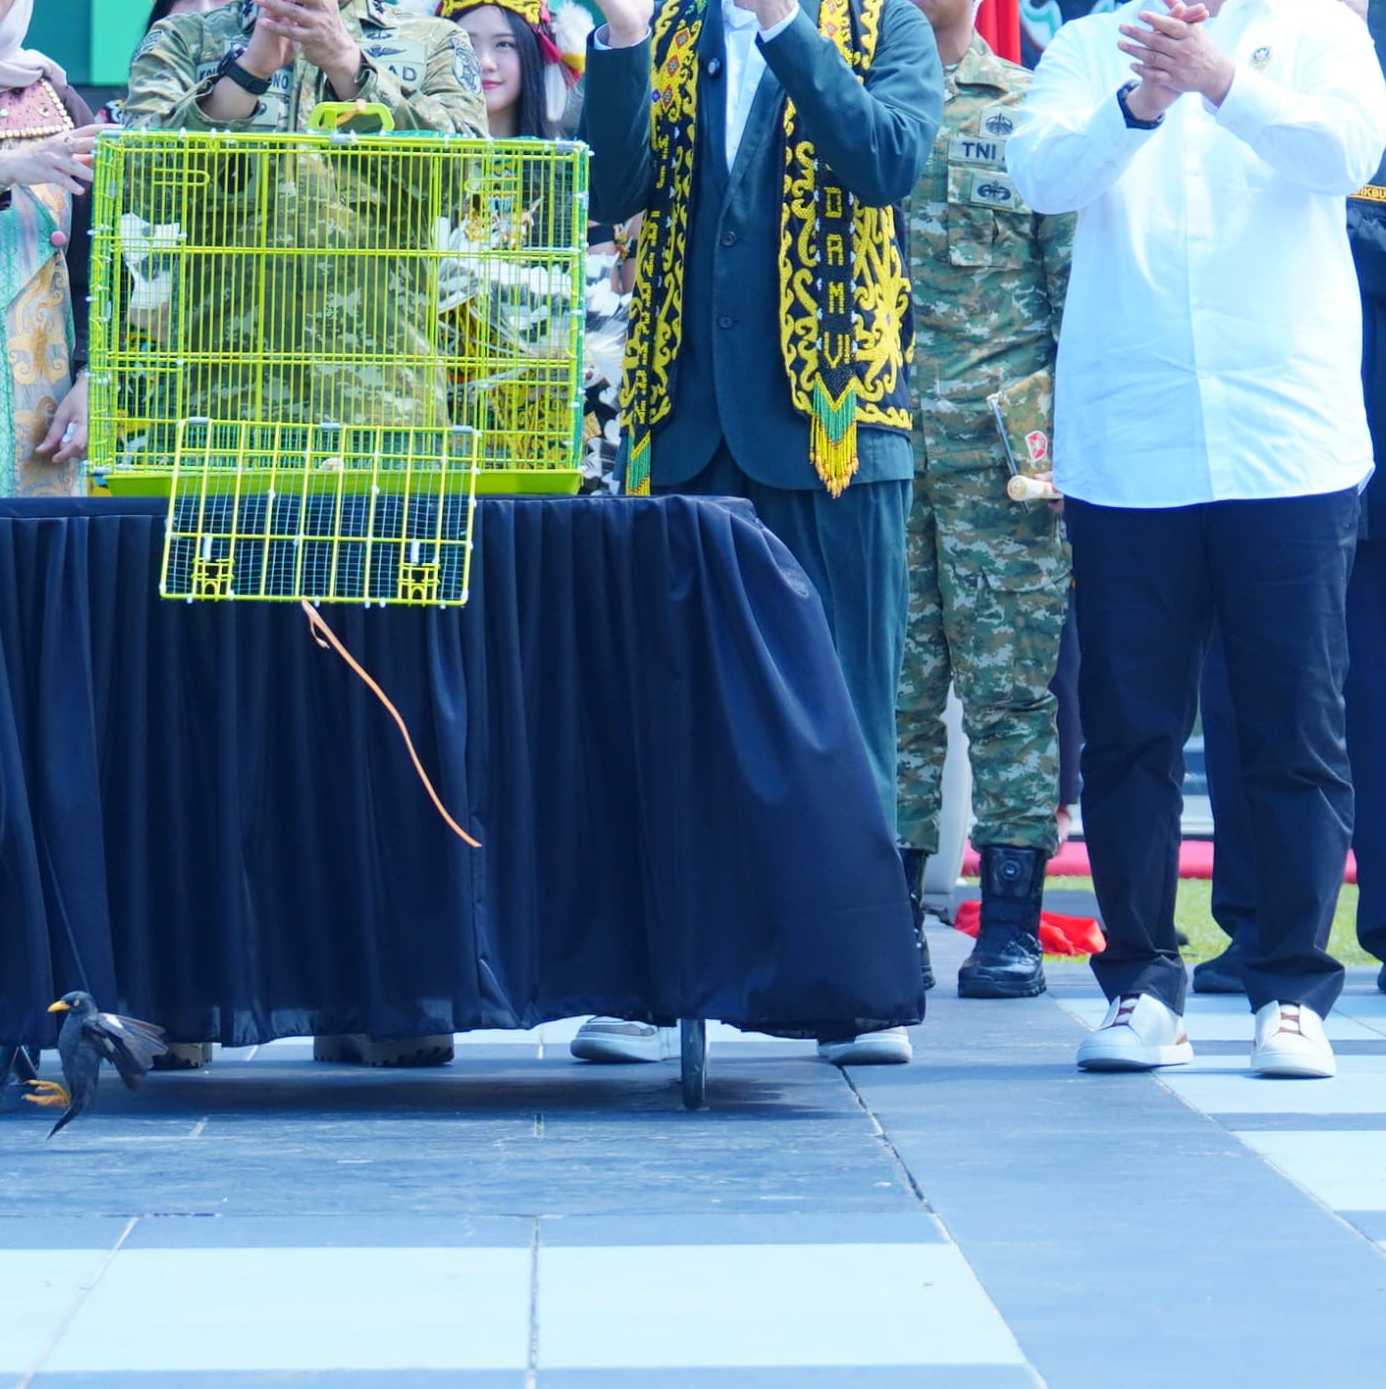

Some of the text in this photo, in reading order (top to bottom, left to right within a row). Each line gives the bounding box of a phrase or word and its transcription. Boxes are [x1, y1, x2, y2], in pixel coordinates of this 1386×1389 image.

[962, 141, 997, 161] TNI
[823, 163, 851, 369] DAM VI
